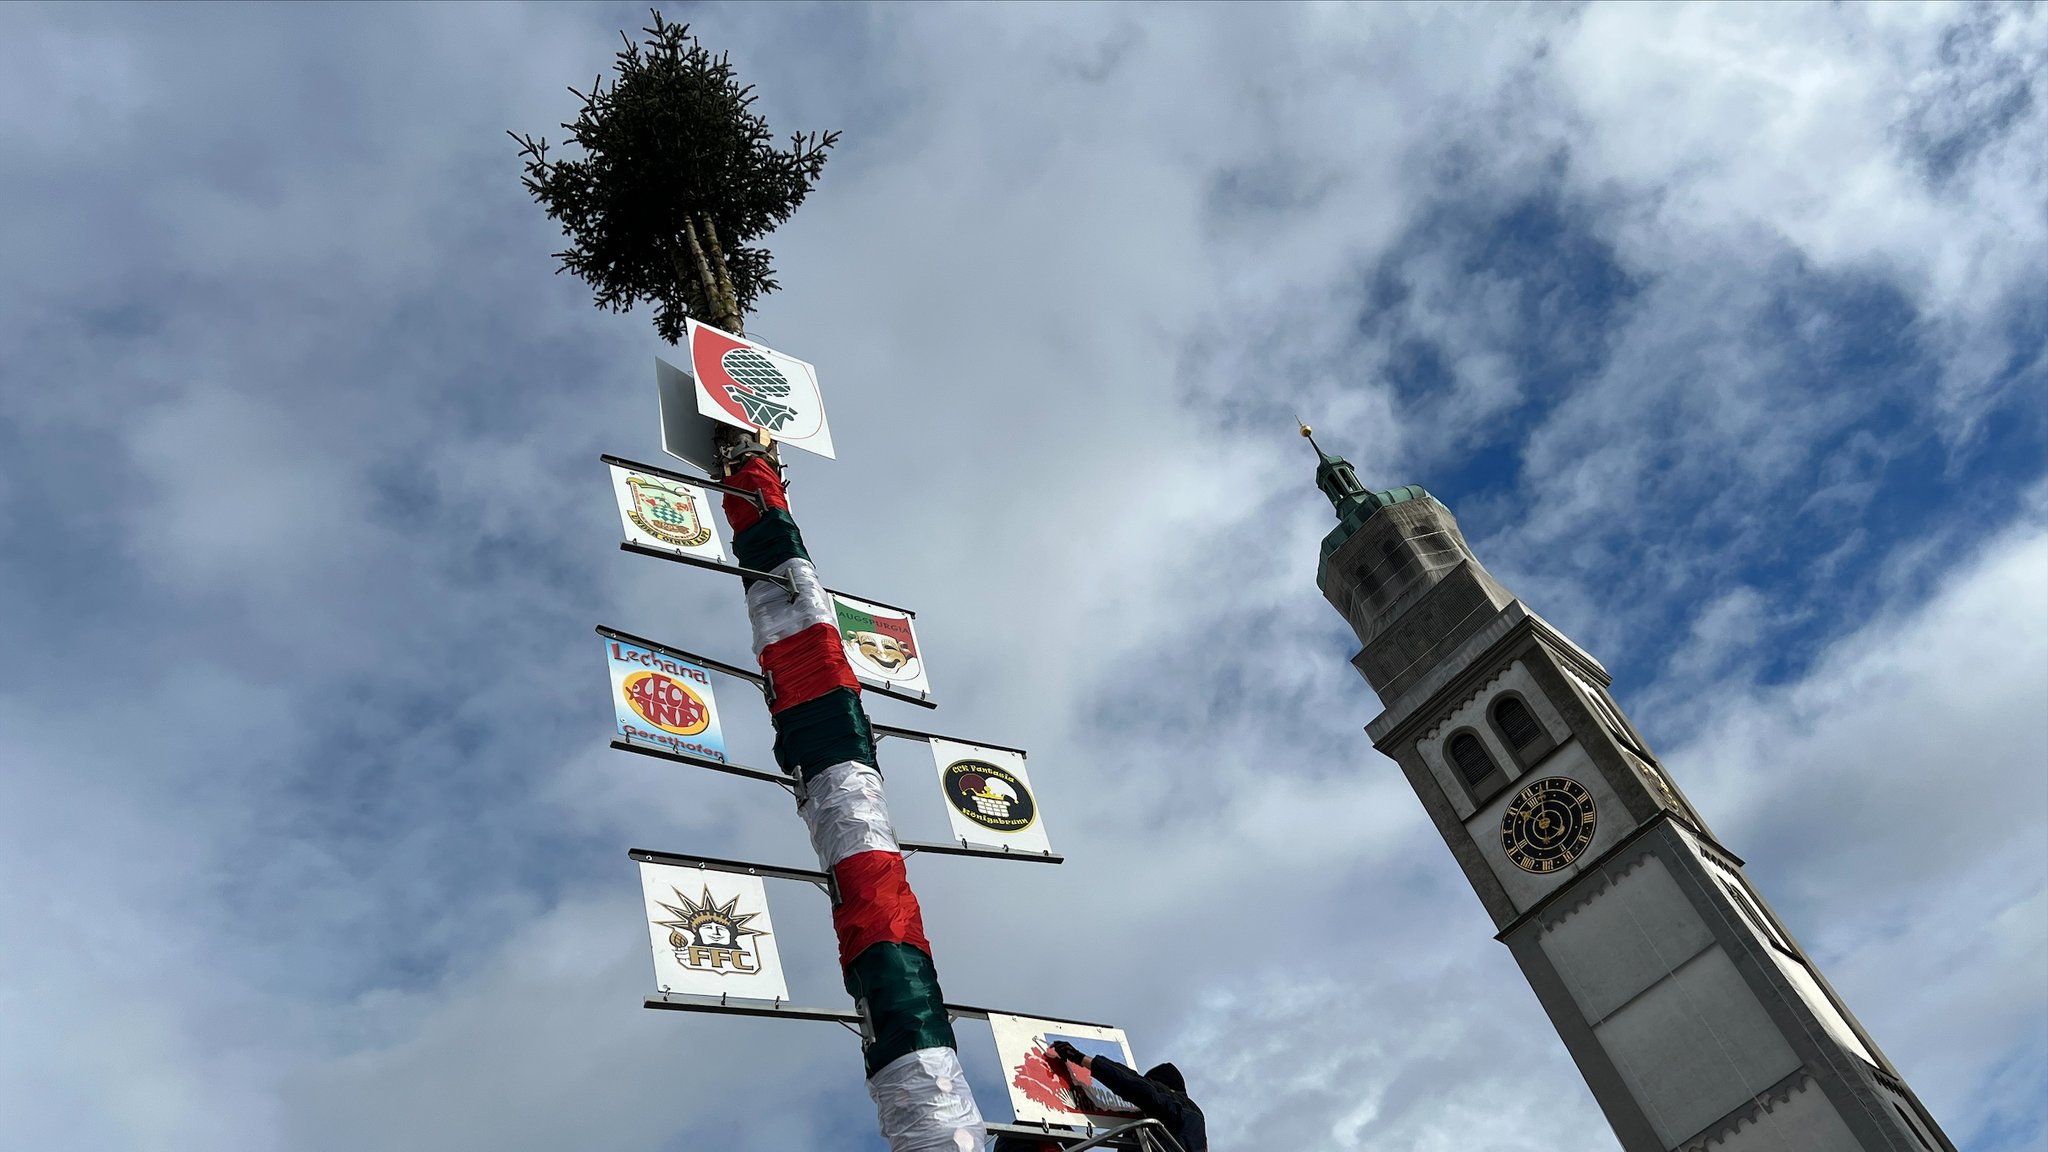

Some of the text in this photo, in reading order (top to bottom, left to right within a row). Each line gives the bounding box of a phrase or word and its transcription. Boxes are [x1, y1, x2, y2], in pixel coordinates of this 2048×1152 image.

[838, 611, 910, 634] AUGSPURGIA
[611, 641, 708, 685] Lechana
[970, 764, 1015, 783] Fantasia
[962, 807, 1029, 826] Königsbrunn
[688, 946, 754, 971] FFC
